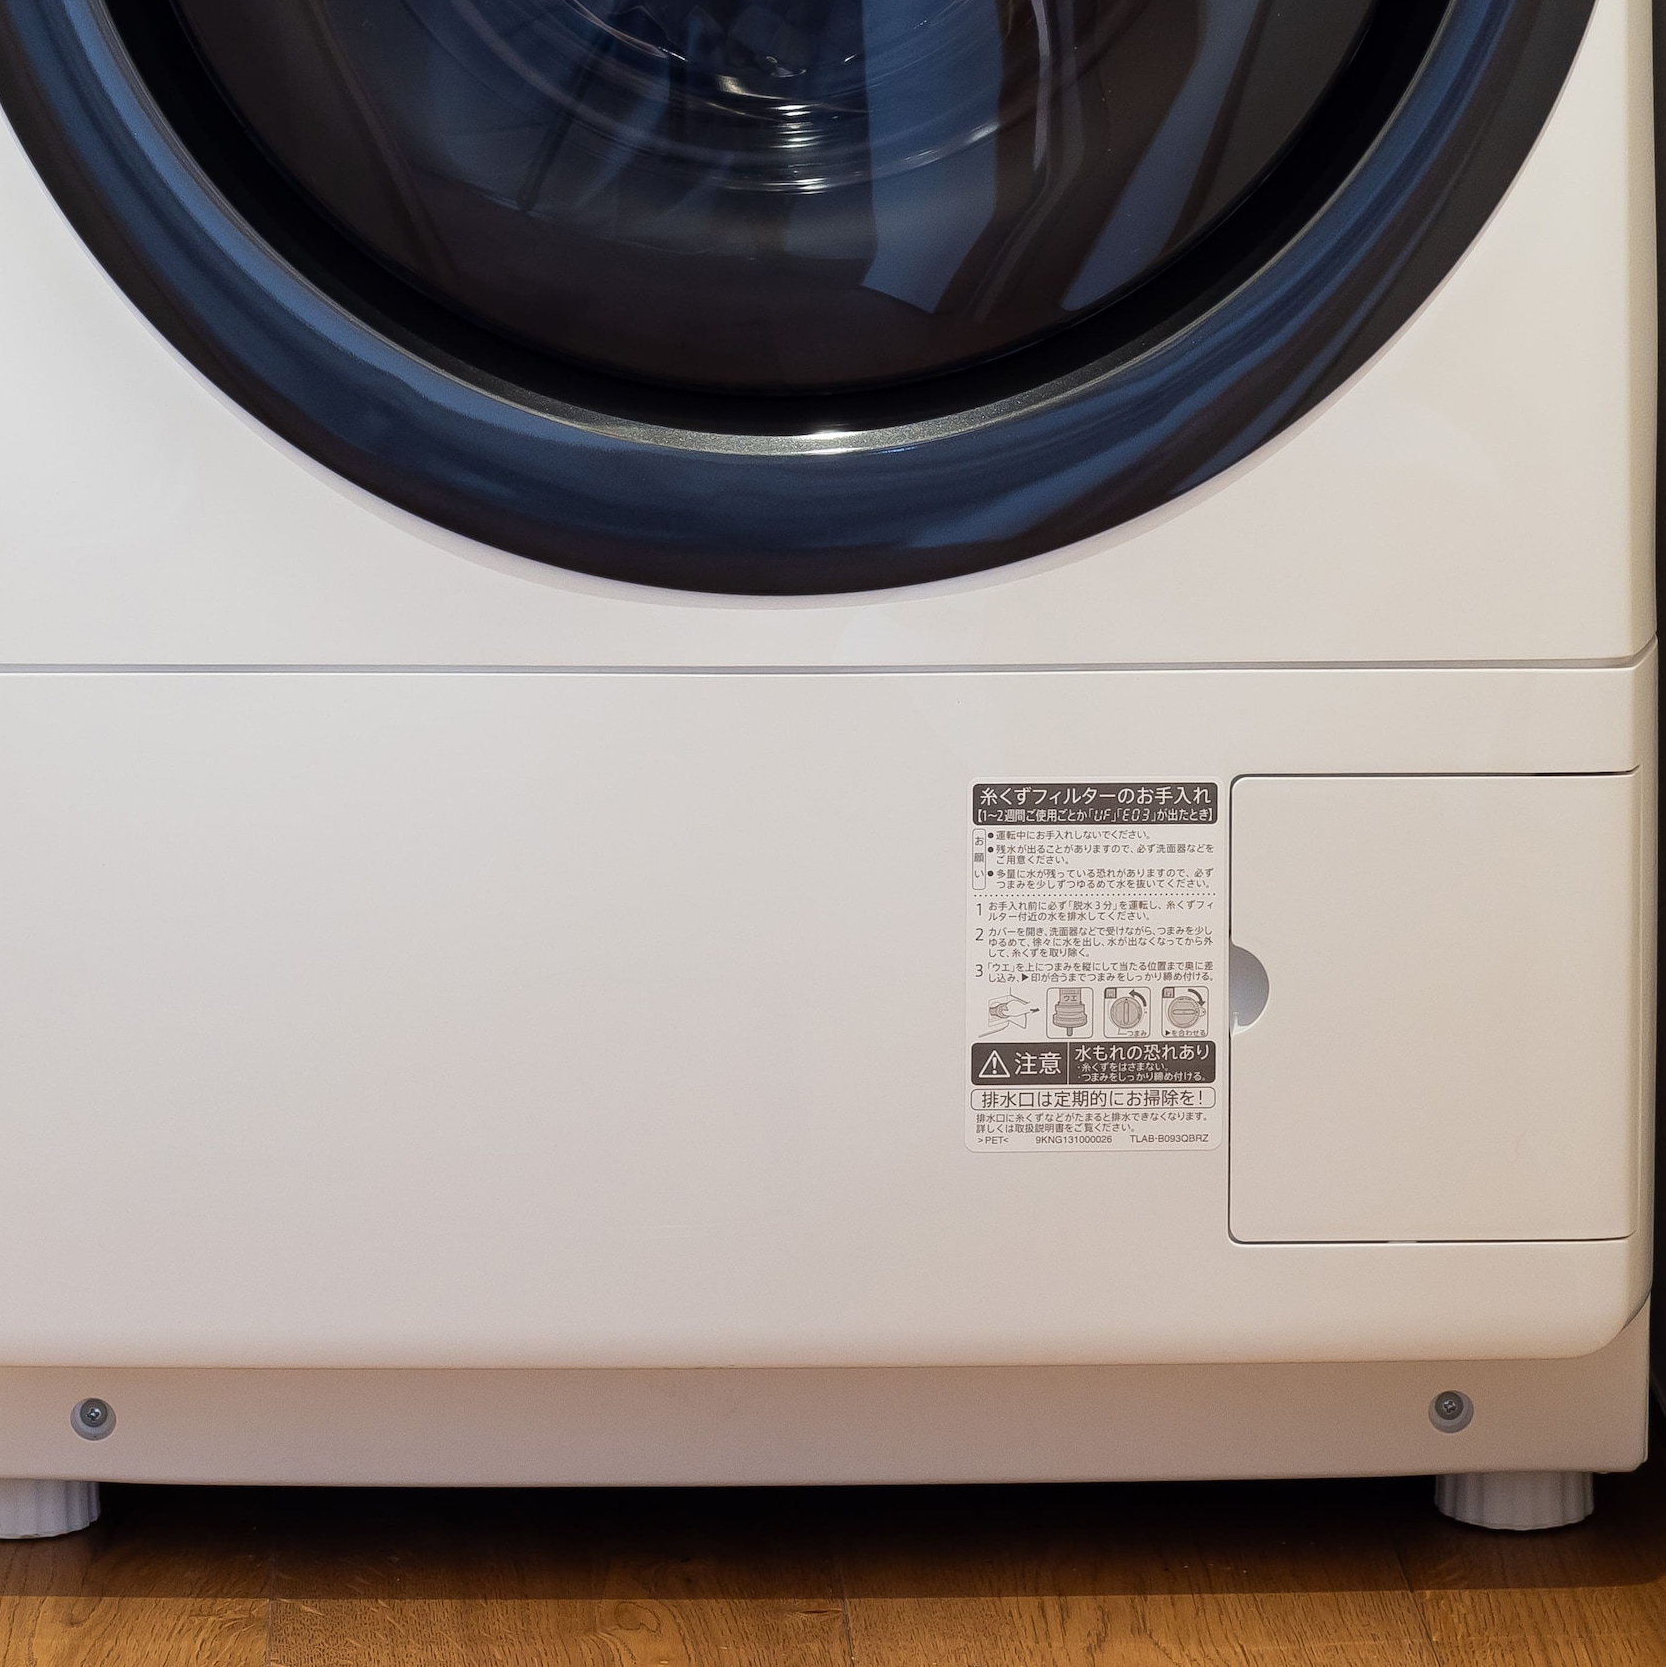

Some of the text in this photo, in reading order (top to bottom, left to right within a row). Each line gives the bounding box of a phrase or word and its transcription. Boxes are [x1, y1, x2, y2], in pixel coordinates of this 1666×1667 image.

[980, 787, 1211, 805] 糸くずフィルターのお手入れ
[997, 855, 1068, 864] ご用意ください。
[977, 903, 981, 916] 1
[989, 911, 1149, 921] ルター付近の水を排水してください。
[976, 928, 983, 941] 2
[989, 948, 1089, 957] して、糸くずを取り除く。
[976, 964, 983, 977] 3
[1126, 1030, 1148, 1038] つまみ
[1075, 1044, 1208, 1061] 水もれの恐れあり
[1015, 1052, 1061, 1074] 注意
[981, 1090, 1204, 1108] 排水口は定期的にお掃除を!
[1036, 1135, 1112, 1144] 9KNG131000026
